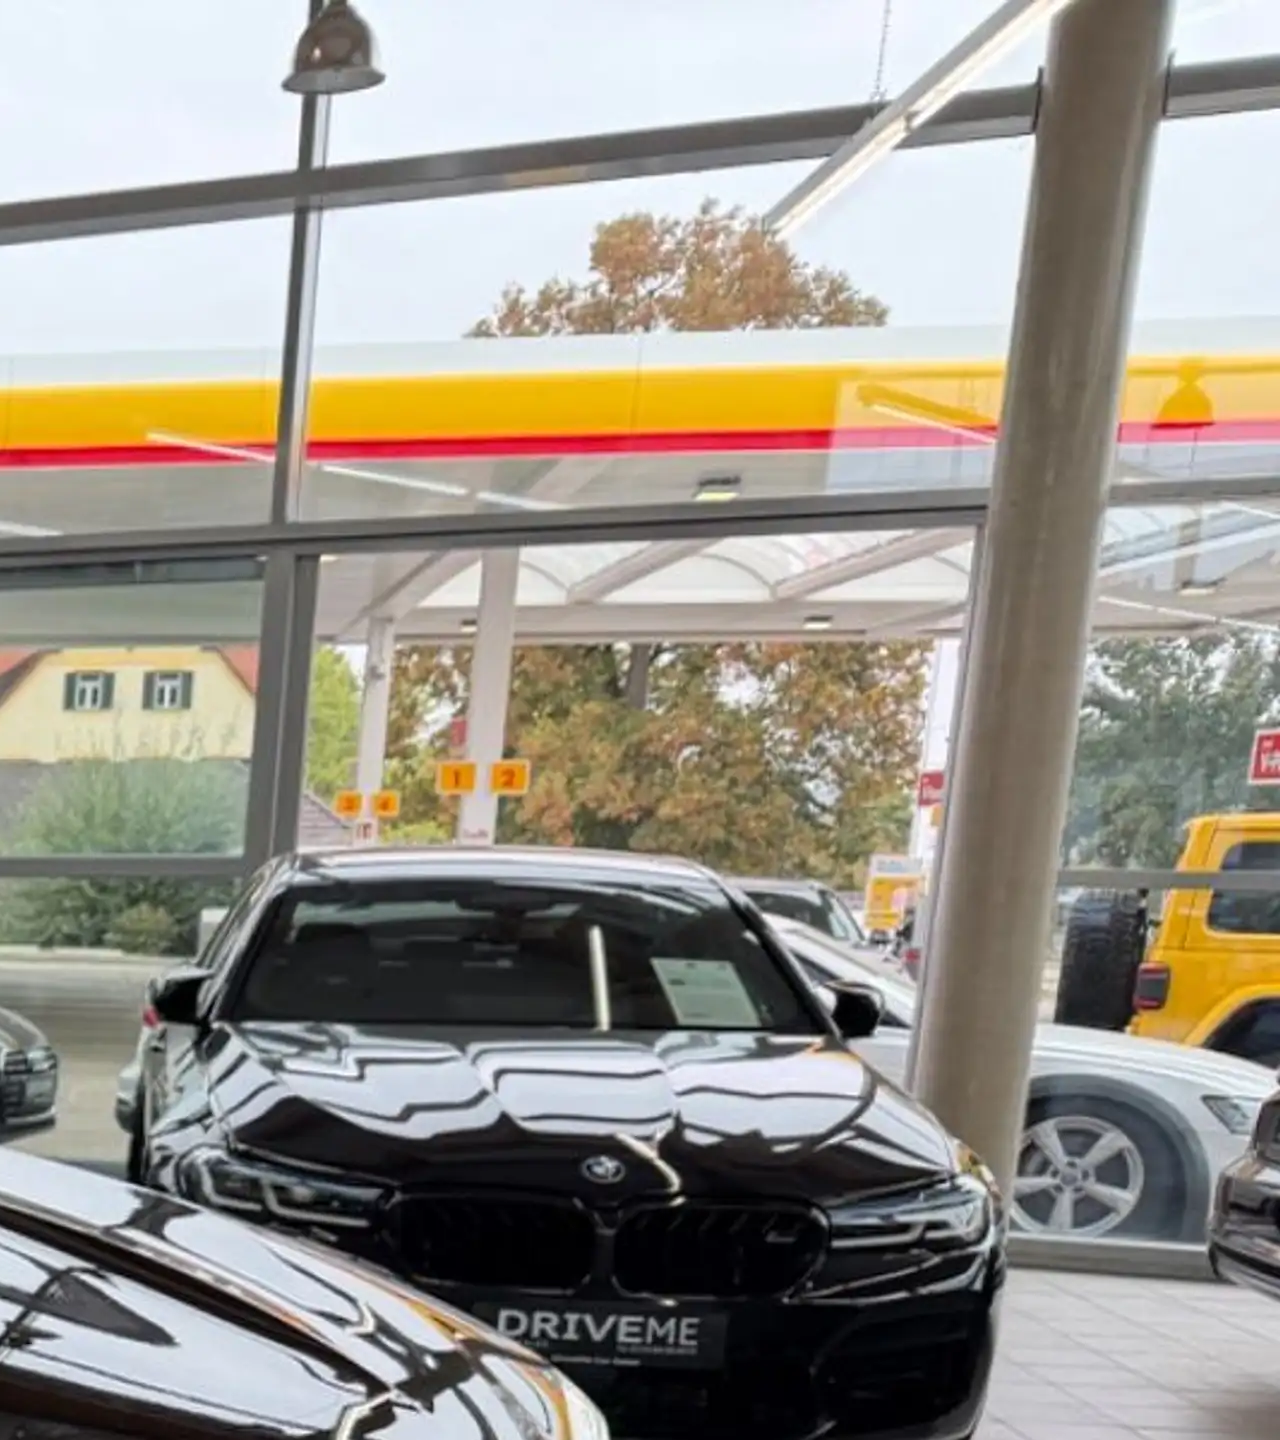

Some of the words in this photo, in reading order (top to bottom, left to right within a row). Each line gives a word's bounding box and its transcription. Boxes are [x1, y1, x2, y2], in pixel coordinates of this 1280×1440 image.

[452, 770, 461, 787] 1
[500, 768, 516, 787] 2
[496, 1308, 700, 1347] DRIVEME
